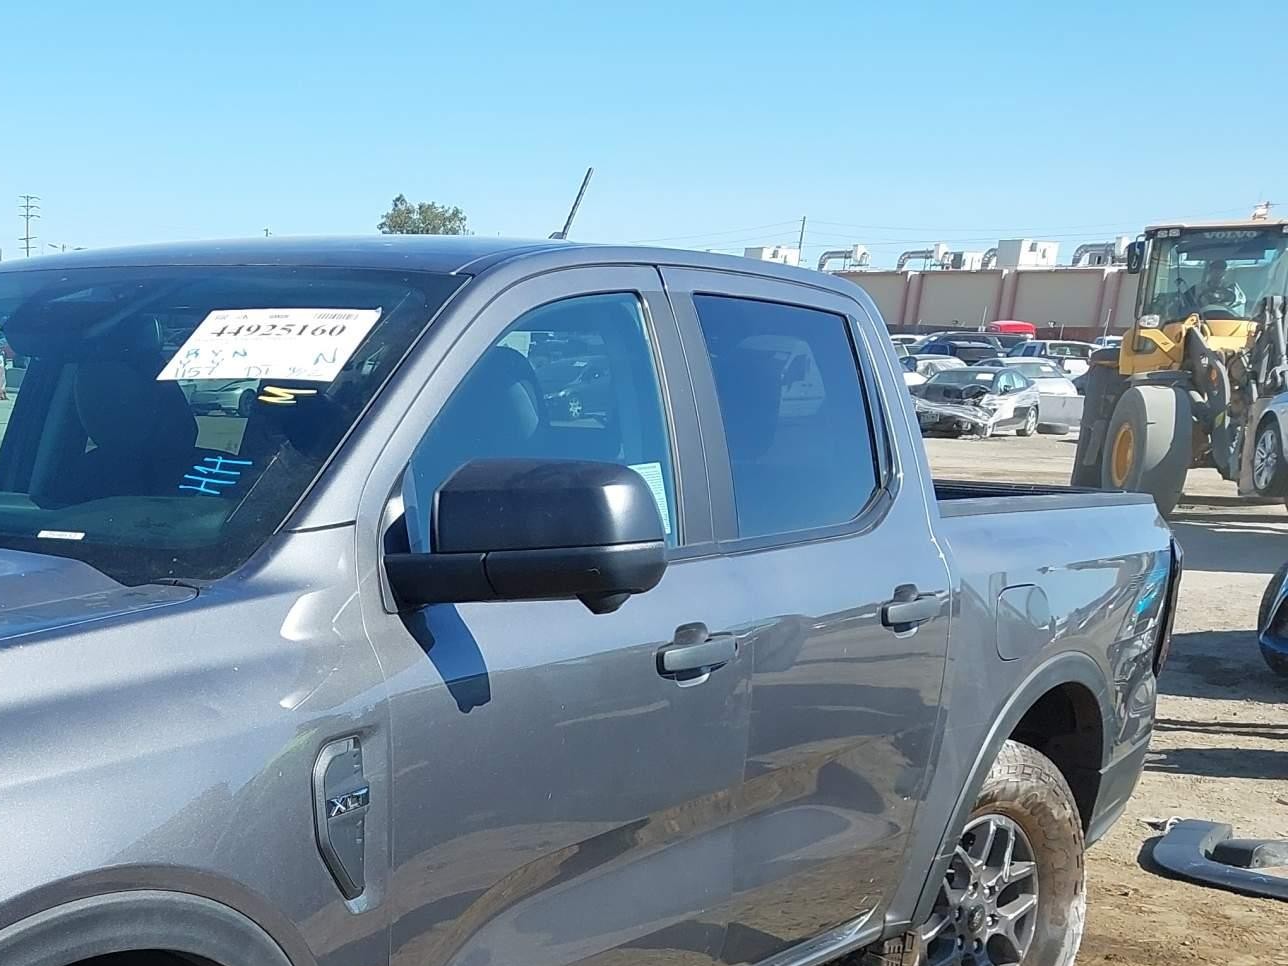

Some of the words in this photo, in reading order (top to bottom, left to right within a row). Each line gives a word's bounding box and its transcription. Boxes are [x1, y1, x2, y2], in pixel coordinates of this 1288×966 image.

[1203, 230, 1257, 239] VOLVO
[209, 324, 347, 337] 44925160
[330, 787, 368, 817] XLT
